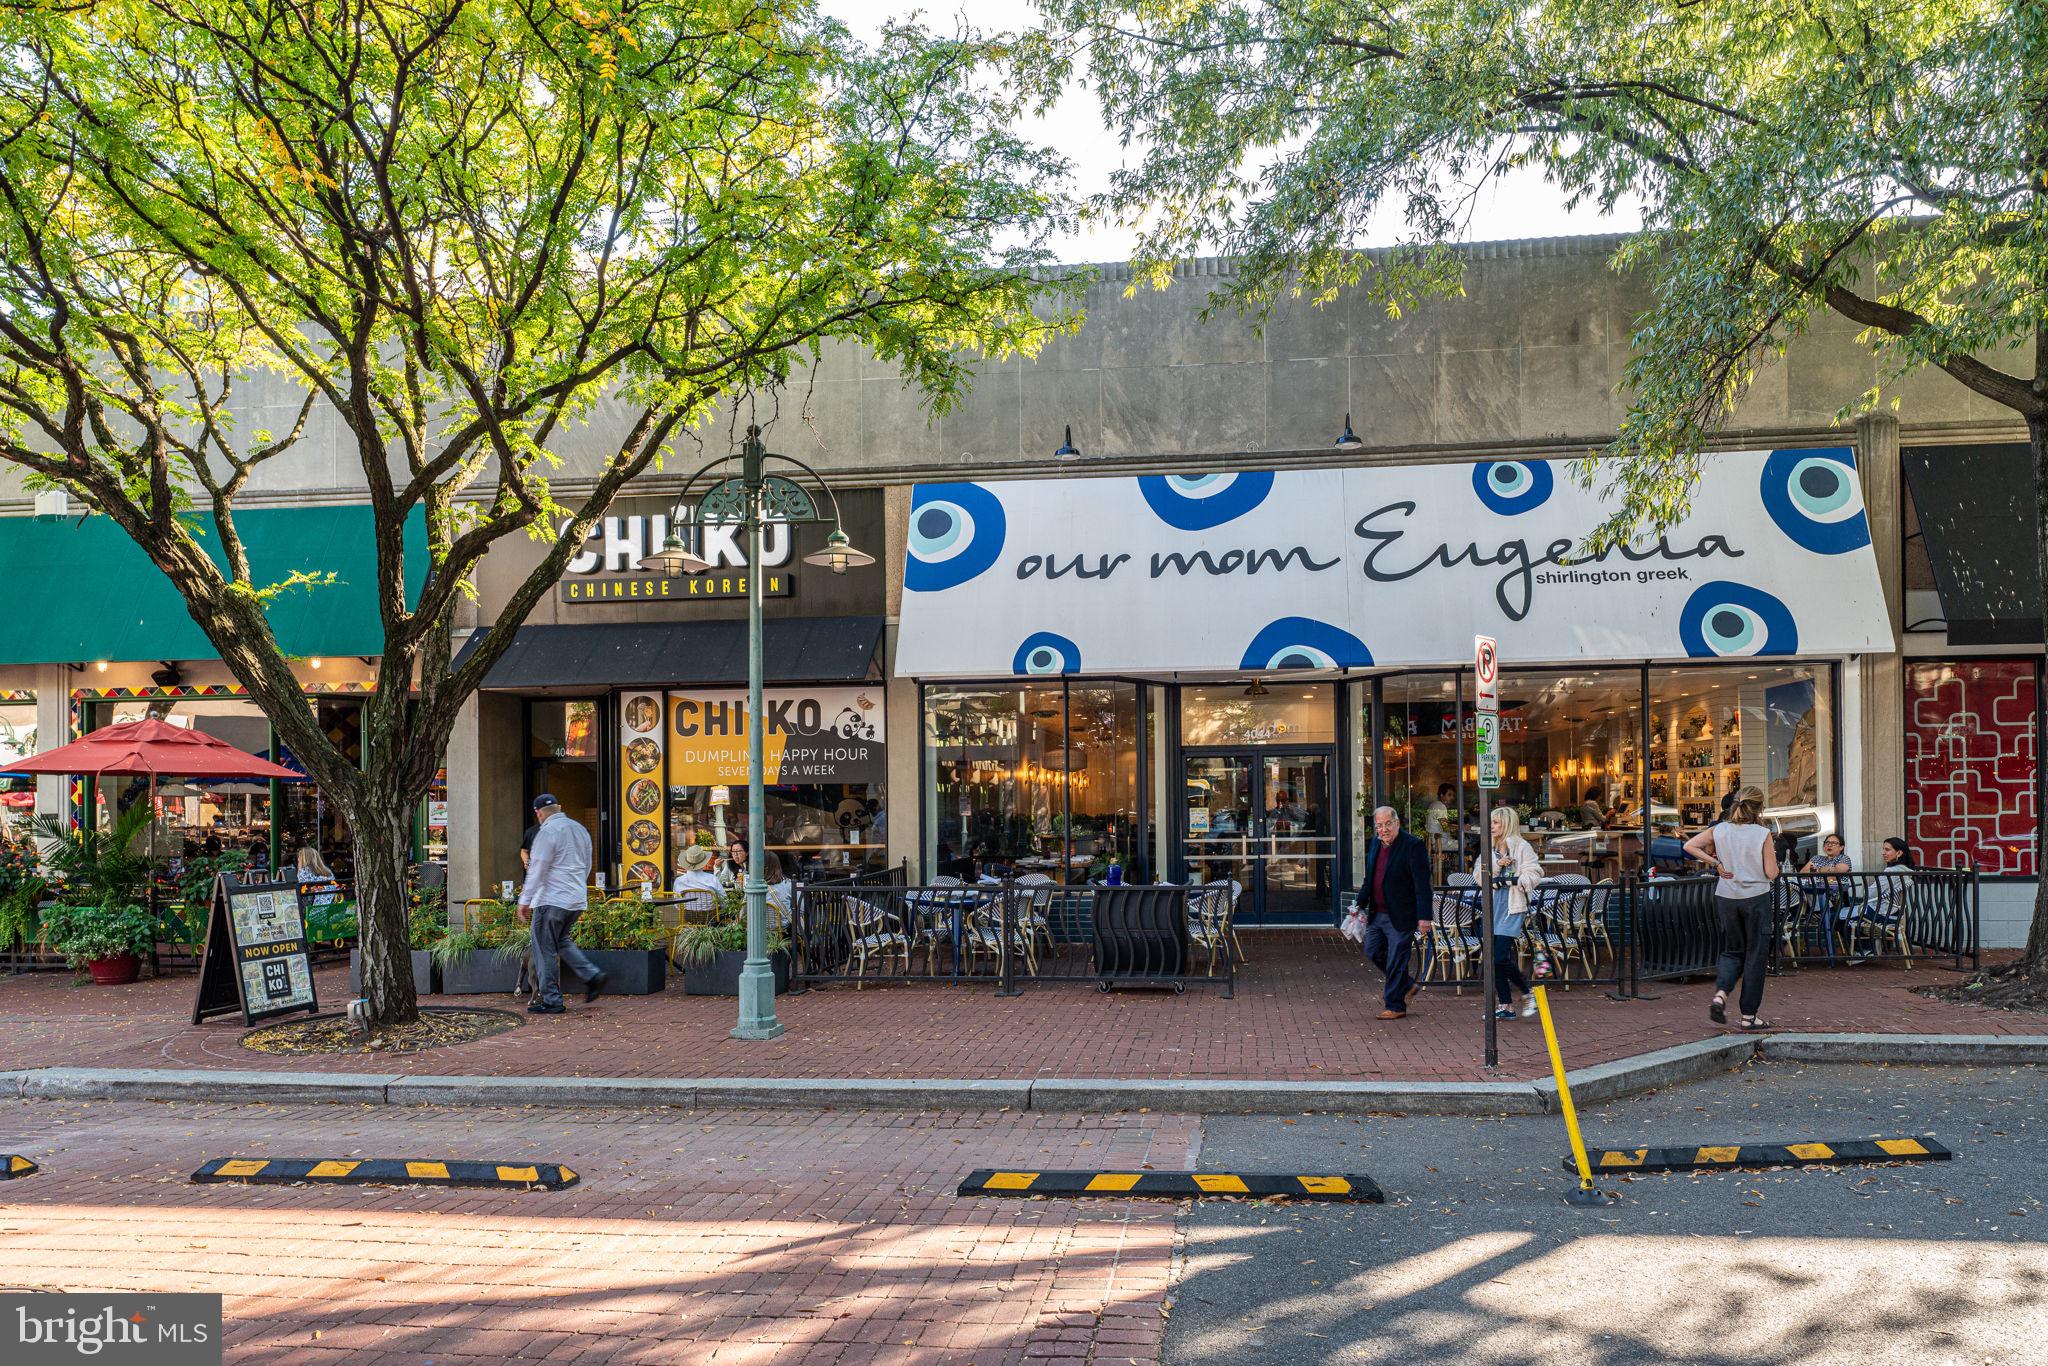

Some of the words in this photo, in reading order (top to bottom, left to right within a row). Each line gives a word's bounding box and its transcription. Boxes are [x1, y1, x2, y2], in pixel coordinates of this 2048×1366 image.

[1017, 553, 1131, 580] our
[1151, 546, 1342, 579] mom
[1354, 501, 1745, 622] Eugenia
[1536, 570, 1631, 585] shirlington
[1637, 567, 1688, 583] greek
[570, 580, 670, 598] CHINESE
[690, 577, 780, 595] KOREN
[685, 750, 764, 763] DUMPLIN
[770, 749, 819, 762] HAPPY
[824, 748, 869, 761] HOUR
[791, 765, 800, 775] A
[803, 764, 835, 775] WEEK
[245, 946, 269, 958] NOW
[272, 942, 298, 954] OPEN
[266, 964, 285, 977] CHI
[268, 978, 283, 991] KO
